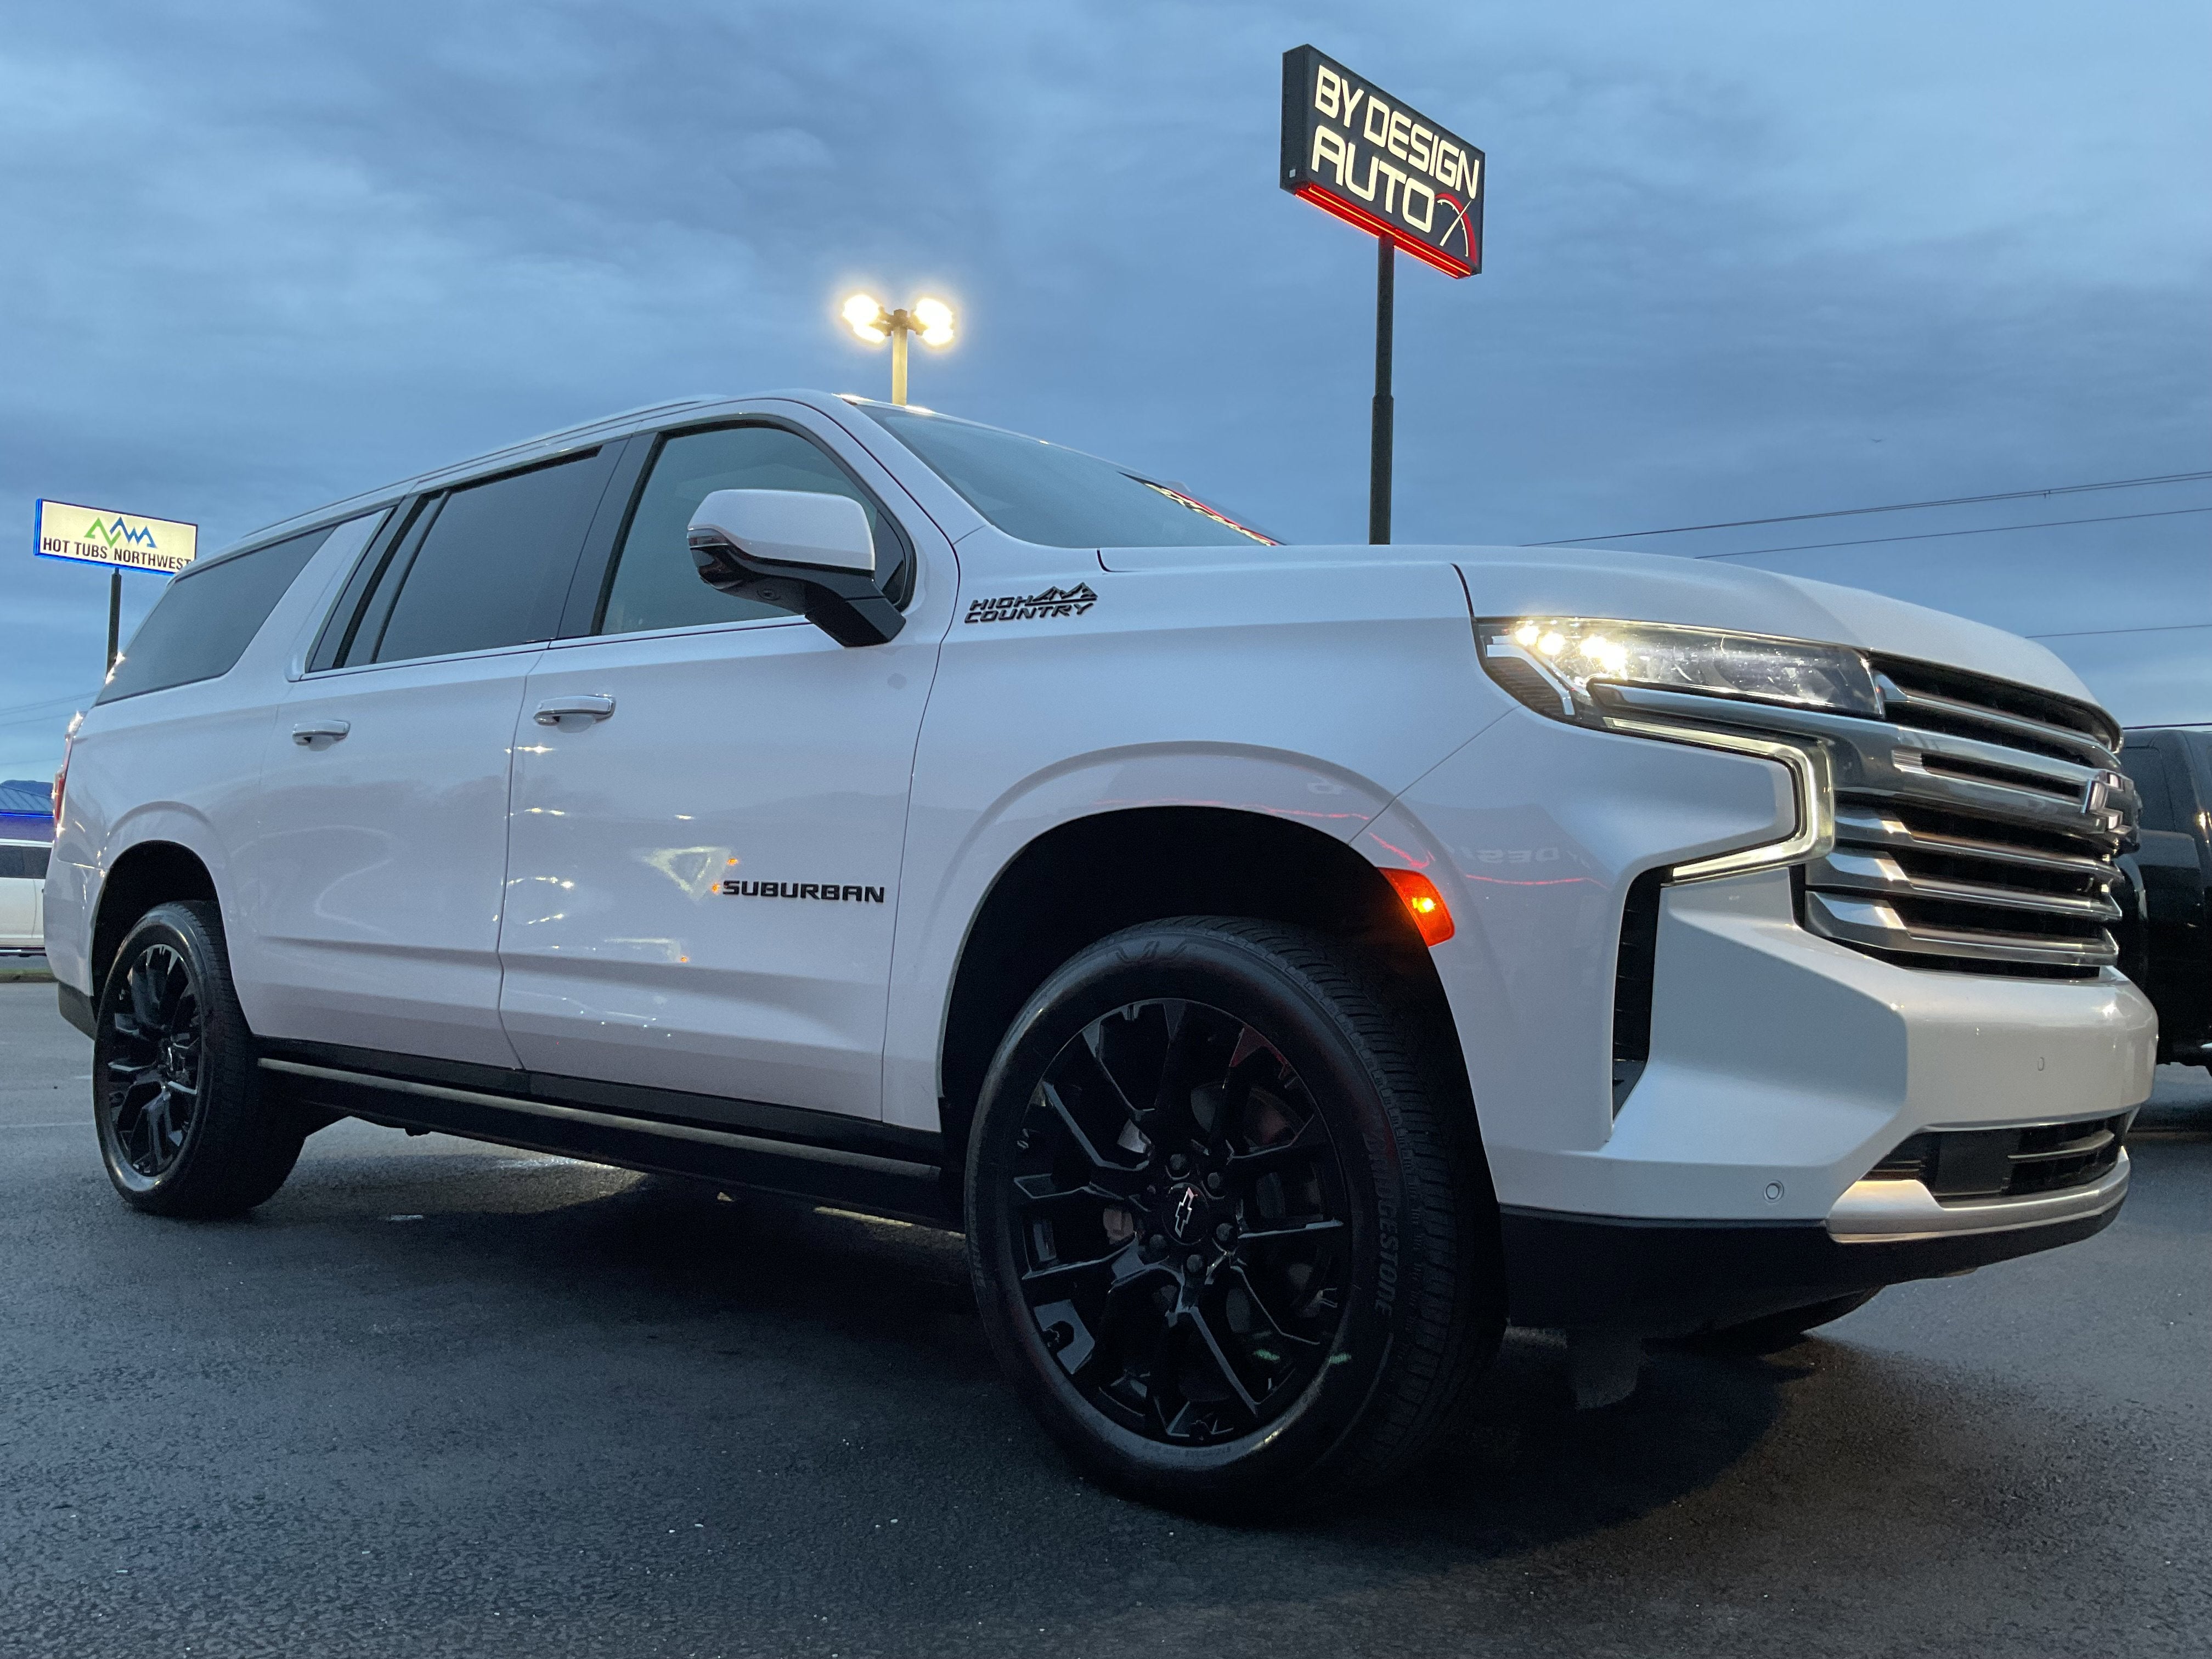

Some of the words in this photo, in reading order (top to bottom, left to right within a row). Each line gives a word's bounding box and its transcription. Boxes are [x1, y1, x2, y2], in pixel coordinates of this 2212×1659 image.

[1314, 64, 1364, 128] BY
[1364, 95, 1480, 199] DESIGN
[1311, 125, 1435, 233] AUTO
[43, 537, 71, 552] HOT
[74, 541, 108, 559] TUBS
[114, 548, 191, 571] NORTHWEST
[964, 602, 1094, 624] COUNTRY
[969, 595, 1034, 611] HIGH
[723, 880, 885, 903] SUBURBAN
[1361, 1131, 1399, 1318] BRIDGESTONE
